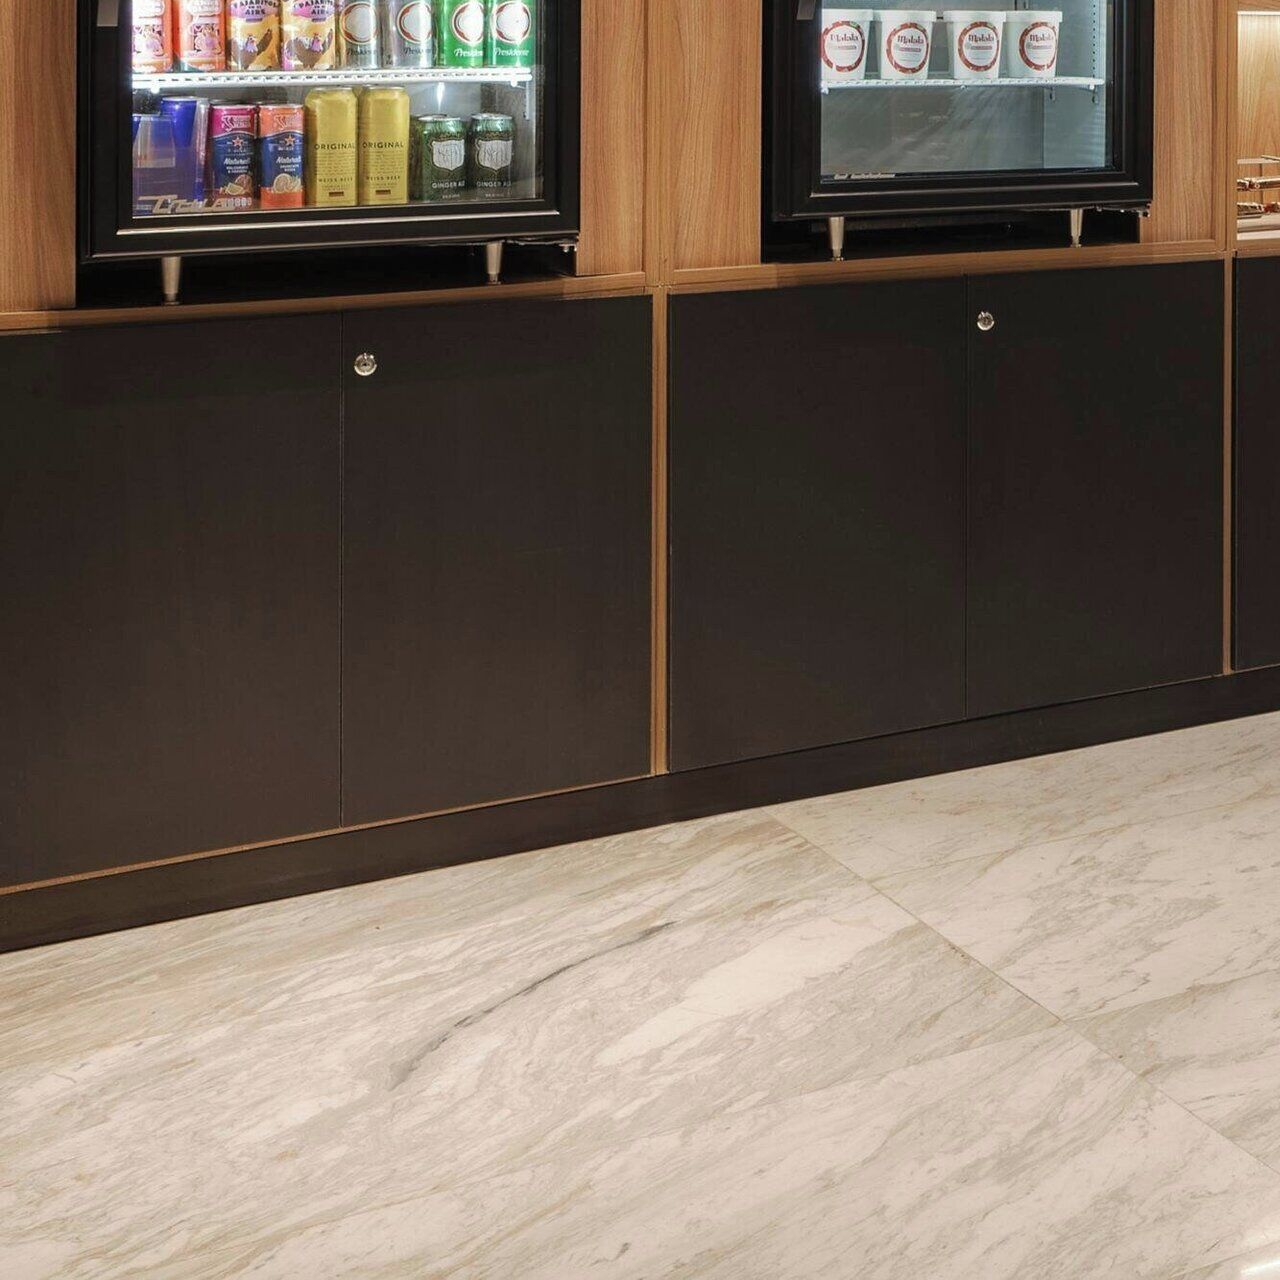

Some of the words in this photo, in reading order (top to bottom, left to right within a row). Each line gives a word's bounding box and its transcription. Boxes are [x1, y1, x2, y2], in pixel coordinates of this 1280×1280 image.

[830, 33, 859, 43] Malala
[897, 35, 925, 45] Malala
[968, 33, 995, 43] Malala
[362, 141, 404, 149] ORIGINAL
